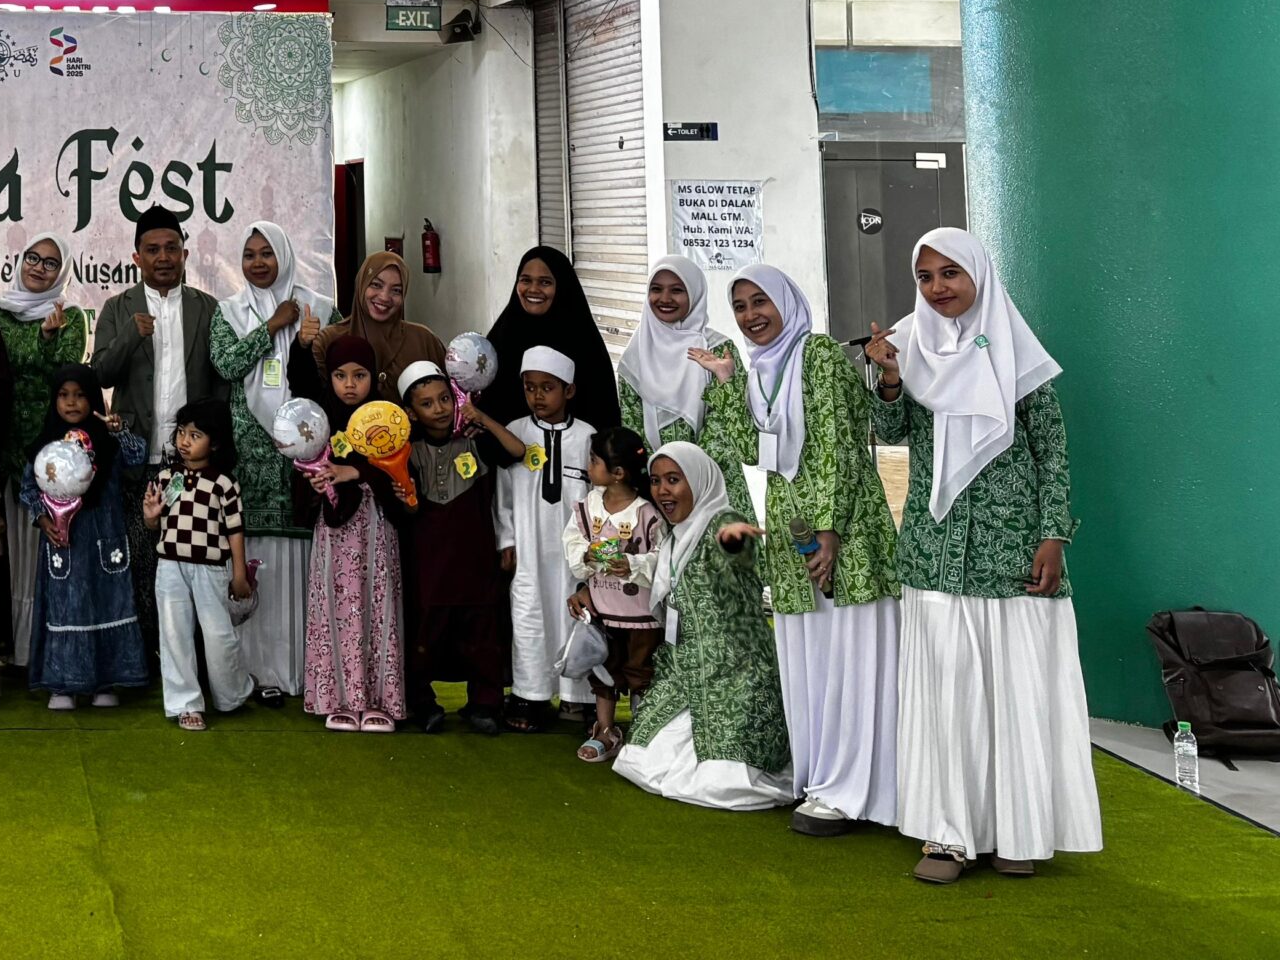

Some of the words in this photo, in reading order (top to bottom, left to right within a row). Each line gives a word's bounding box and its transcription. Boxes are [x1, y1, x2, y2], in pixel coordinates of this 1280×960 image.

[398, 10, 431, 27] EXIT
[66, 56, 83, 64] HARI
[66, 63, 92, 71] SANTRI
[55, 125, 236, 234] Fest
[677, 185, 692, 194] MS
[694, 185, 724, 194] GLOW
[726, 185, 756, 195] TETAP
[679, 198, 706, 207] BUKA
[708, 199, 718, 208] DI
[720, 199, 756, 208] DALAM
[691, 212, 718, 221] MALL
[720, 212, 745, 221] GTM.
[683, 225, 706, 234] Hub.
[708, 225, 732, 234] Kami
[734, 226, 754, 235] WA:
[683, 238, 711, 248] 08532
[714, 239, 730, 248] 123
[732, 239, 755, 248] 1234
[530, 453, 541, 466] 6
[462, 462, 471, 476] 2
